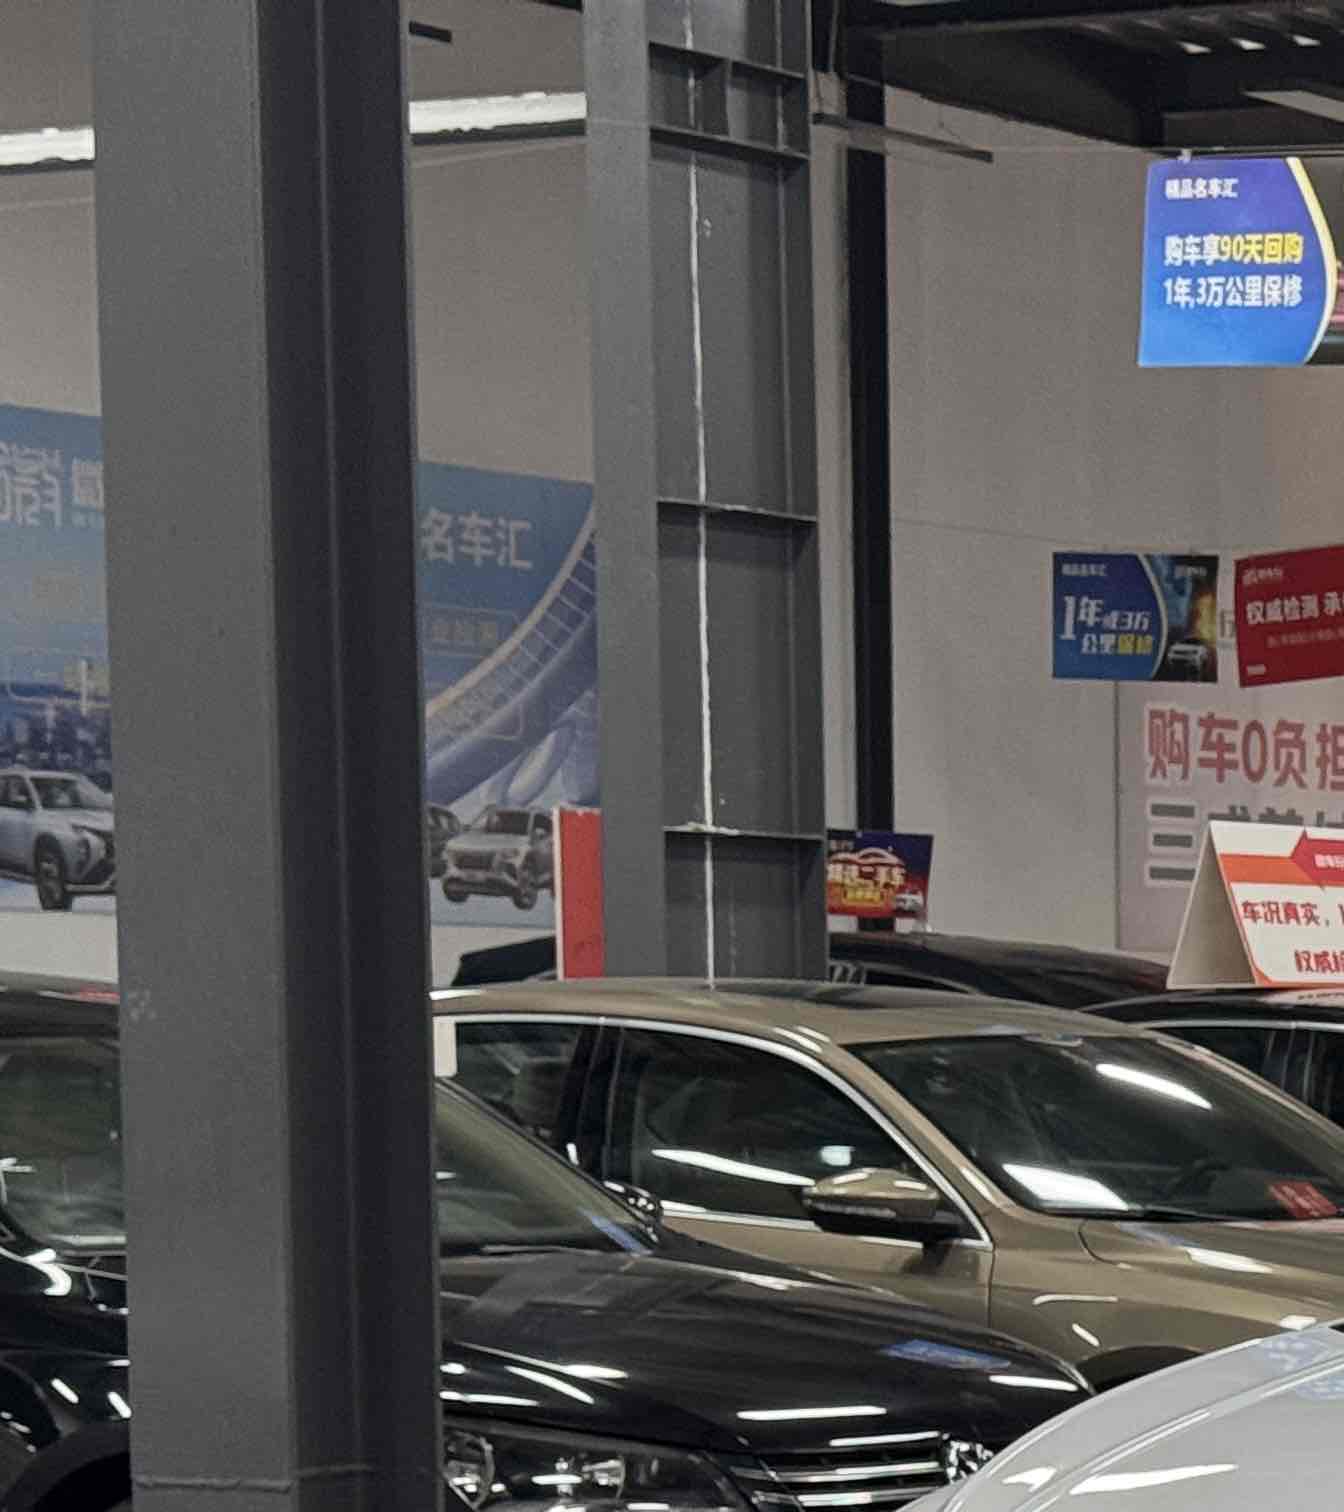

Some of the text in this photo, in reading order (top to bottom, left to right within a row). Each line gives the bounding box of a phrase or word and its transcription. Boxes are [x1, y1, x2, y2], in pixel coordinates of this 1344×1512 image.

[1164, 233, 1304, 266] 购车享90天回购
[420, 508, 533, 571] 名车汇
